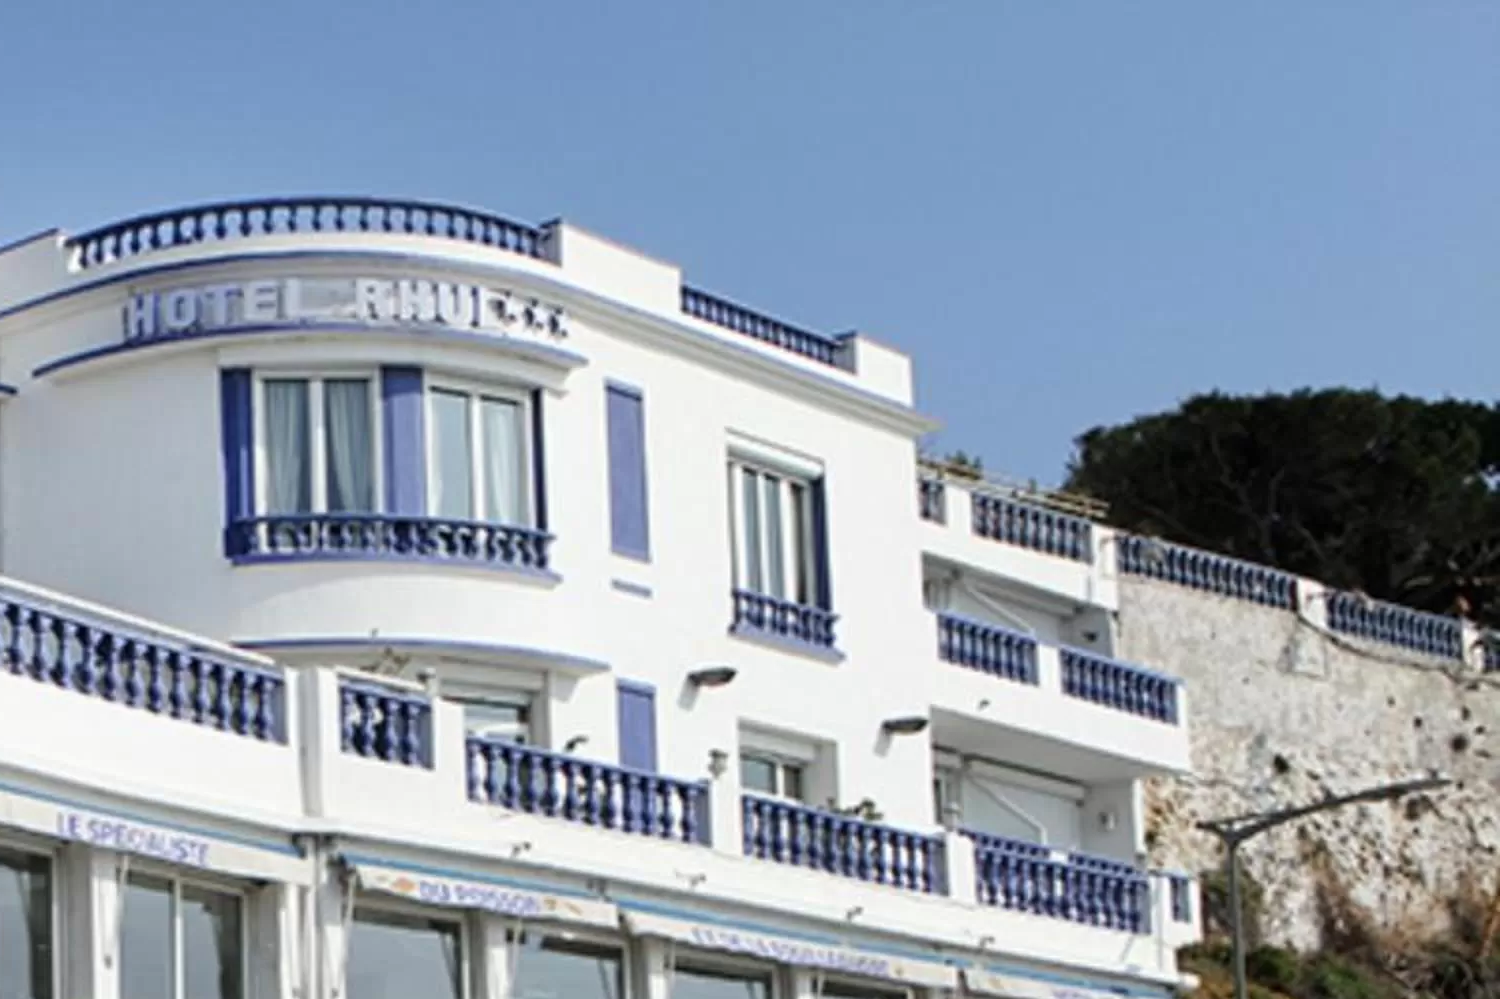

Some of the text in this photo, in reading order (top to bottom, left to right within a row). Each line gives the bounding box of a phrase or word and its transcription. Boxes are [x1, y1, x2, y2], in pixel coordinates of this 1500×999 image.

[127, 278, 508, 340] HOTEL RHUL
[56, 811, 81, 839] LE
